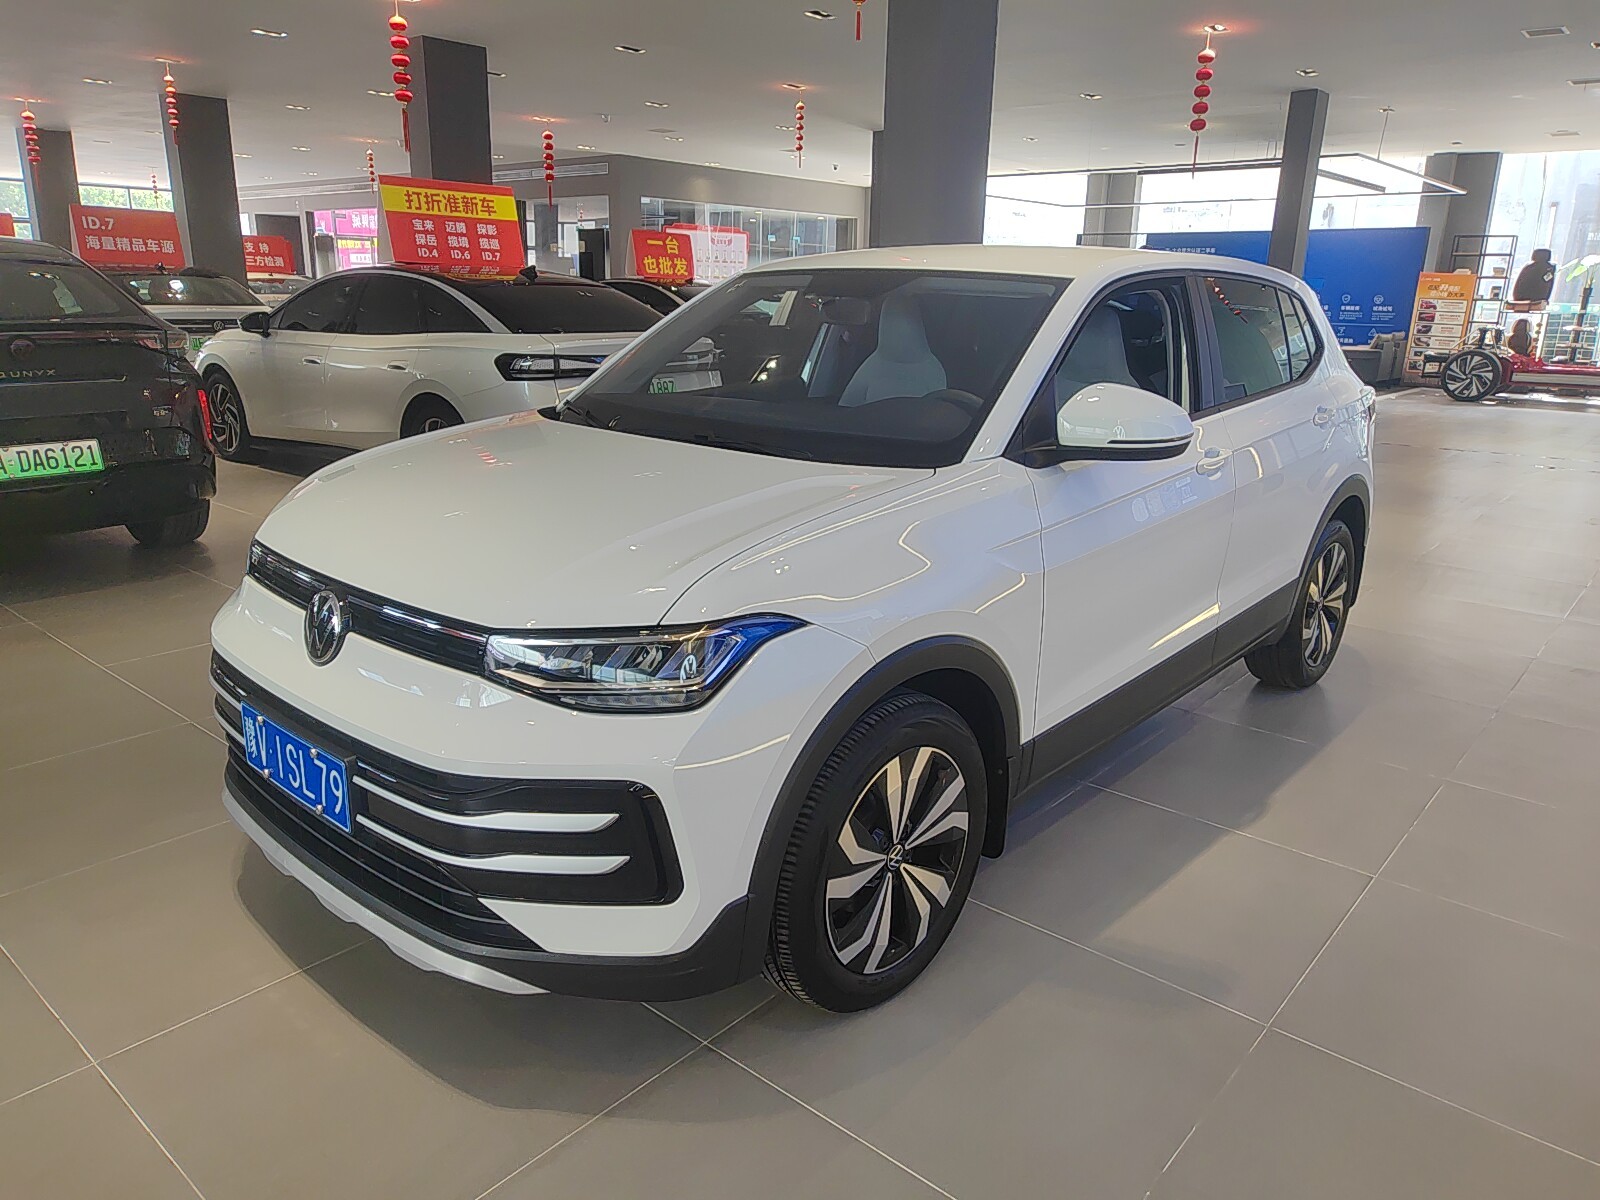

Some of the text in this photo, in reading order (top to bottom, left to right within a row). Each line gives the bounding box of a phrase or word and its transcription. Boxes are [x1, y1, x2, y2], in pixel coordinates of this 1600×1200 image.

[404, 190, 497, 216] 打折准新车
[82, 215, 114, 230] ID.7
[412, 218, 498, 236] 宝来 迈腾 探影
[85, 235, 175, 254] 海量精品车源
[415, 233, 437, 246] 探岳
[647, 236, 679, 255] 一台
[417, 247, 500, 261] ID.4 ID.6 ID.7
[643, 255, 689, 276] 也批发
